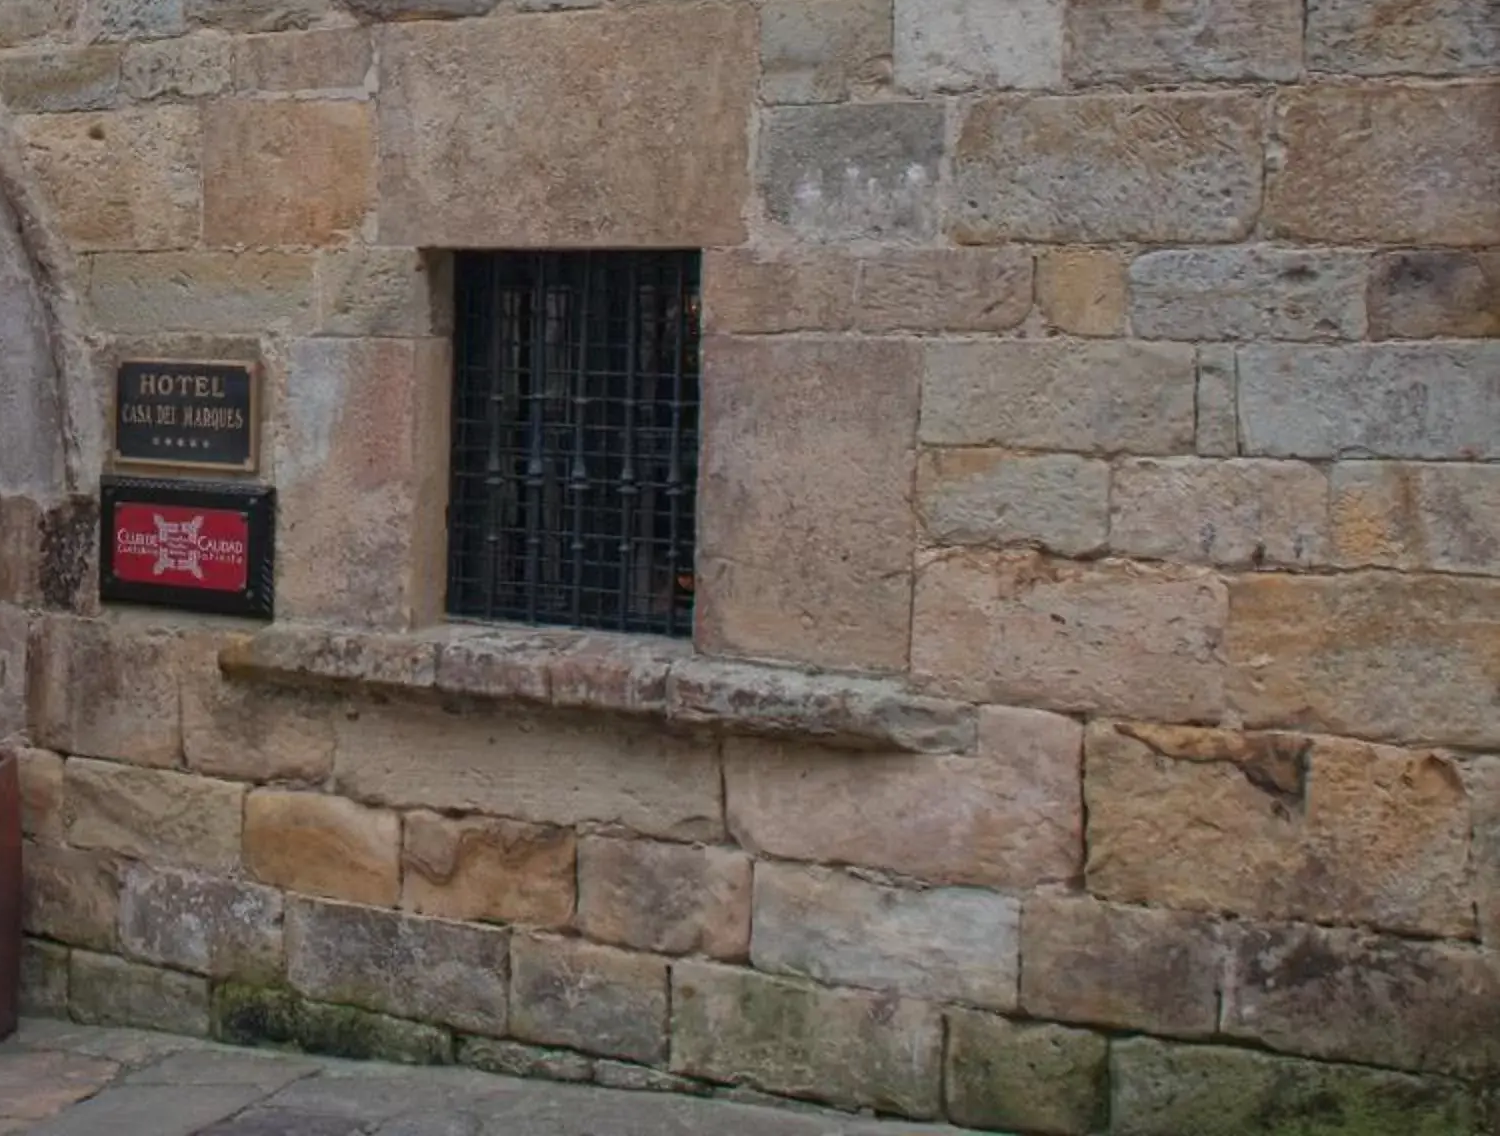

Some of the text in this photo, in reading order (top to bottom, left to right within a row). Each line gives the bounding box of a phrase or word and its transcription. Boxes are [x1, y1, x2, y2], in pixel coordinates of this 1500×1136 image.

[140, 373, 226, 398] HOTEL
[122, 402, 152, 425] CASA
[156, 404, 176, 426] DEL
